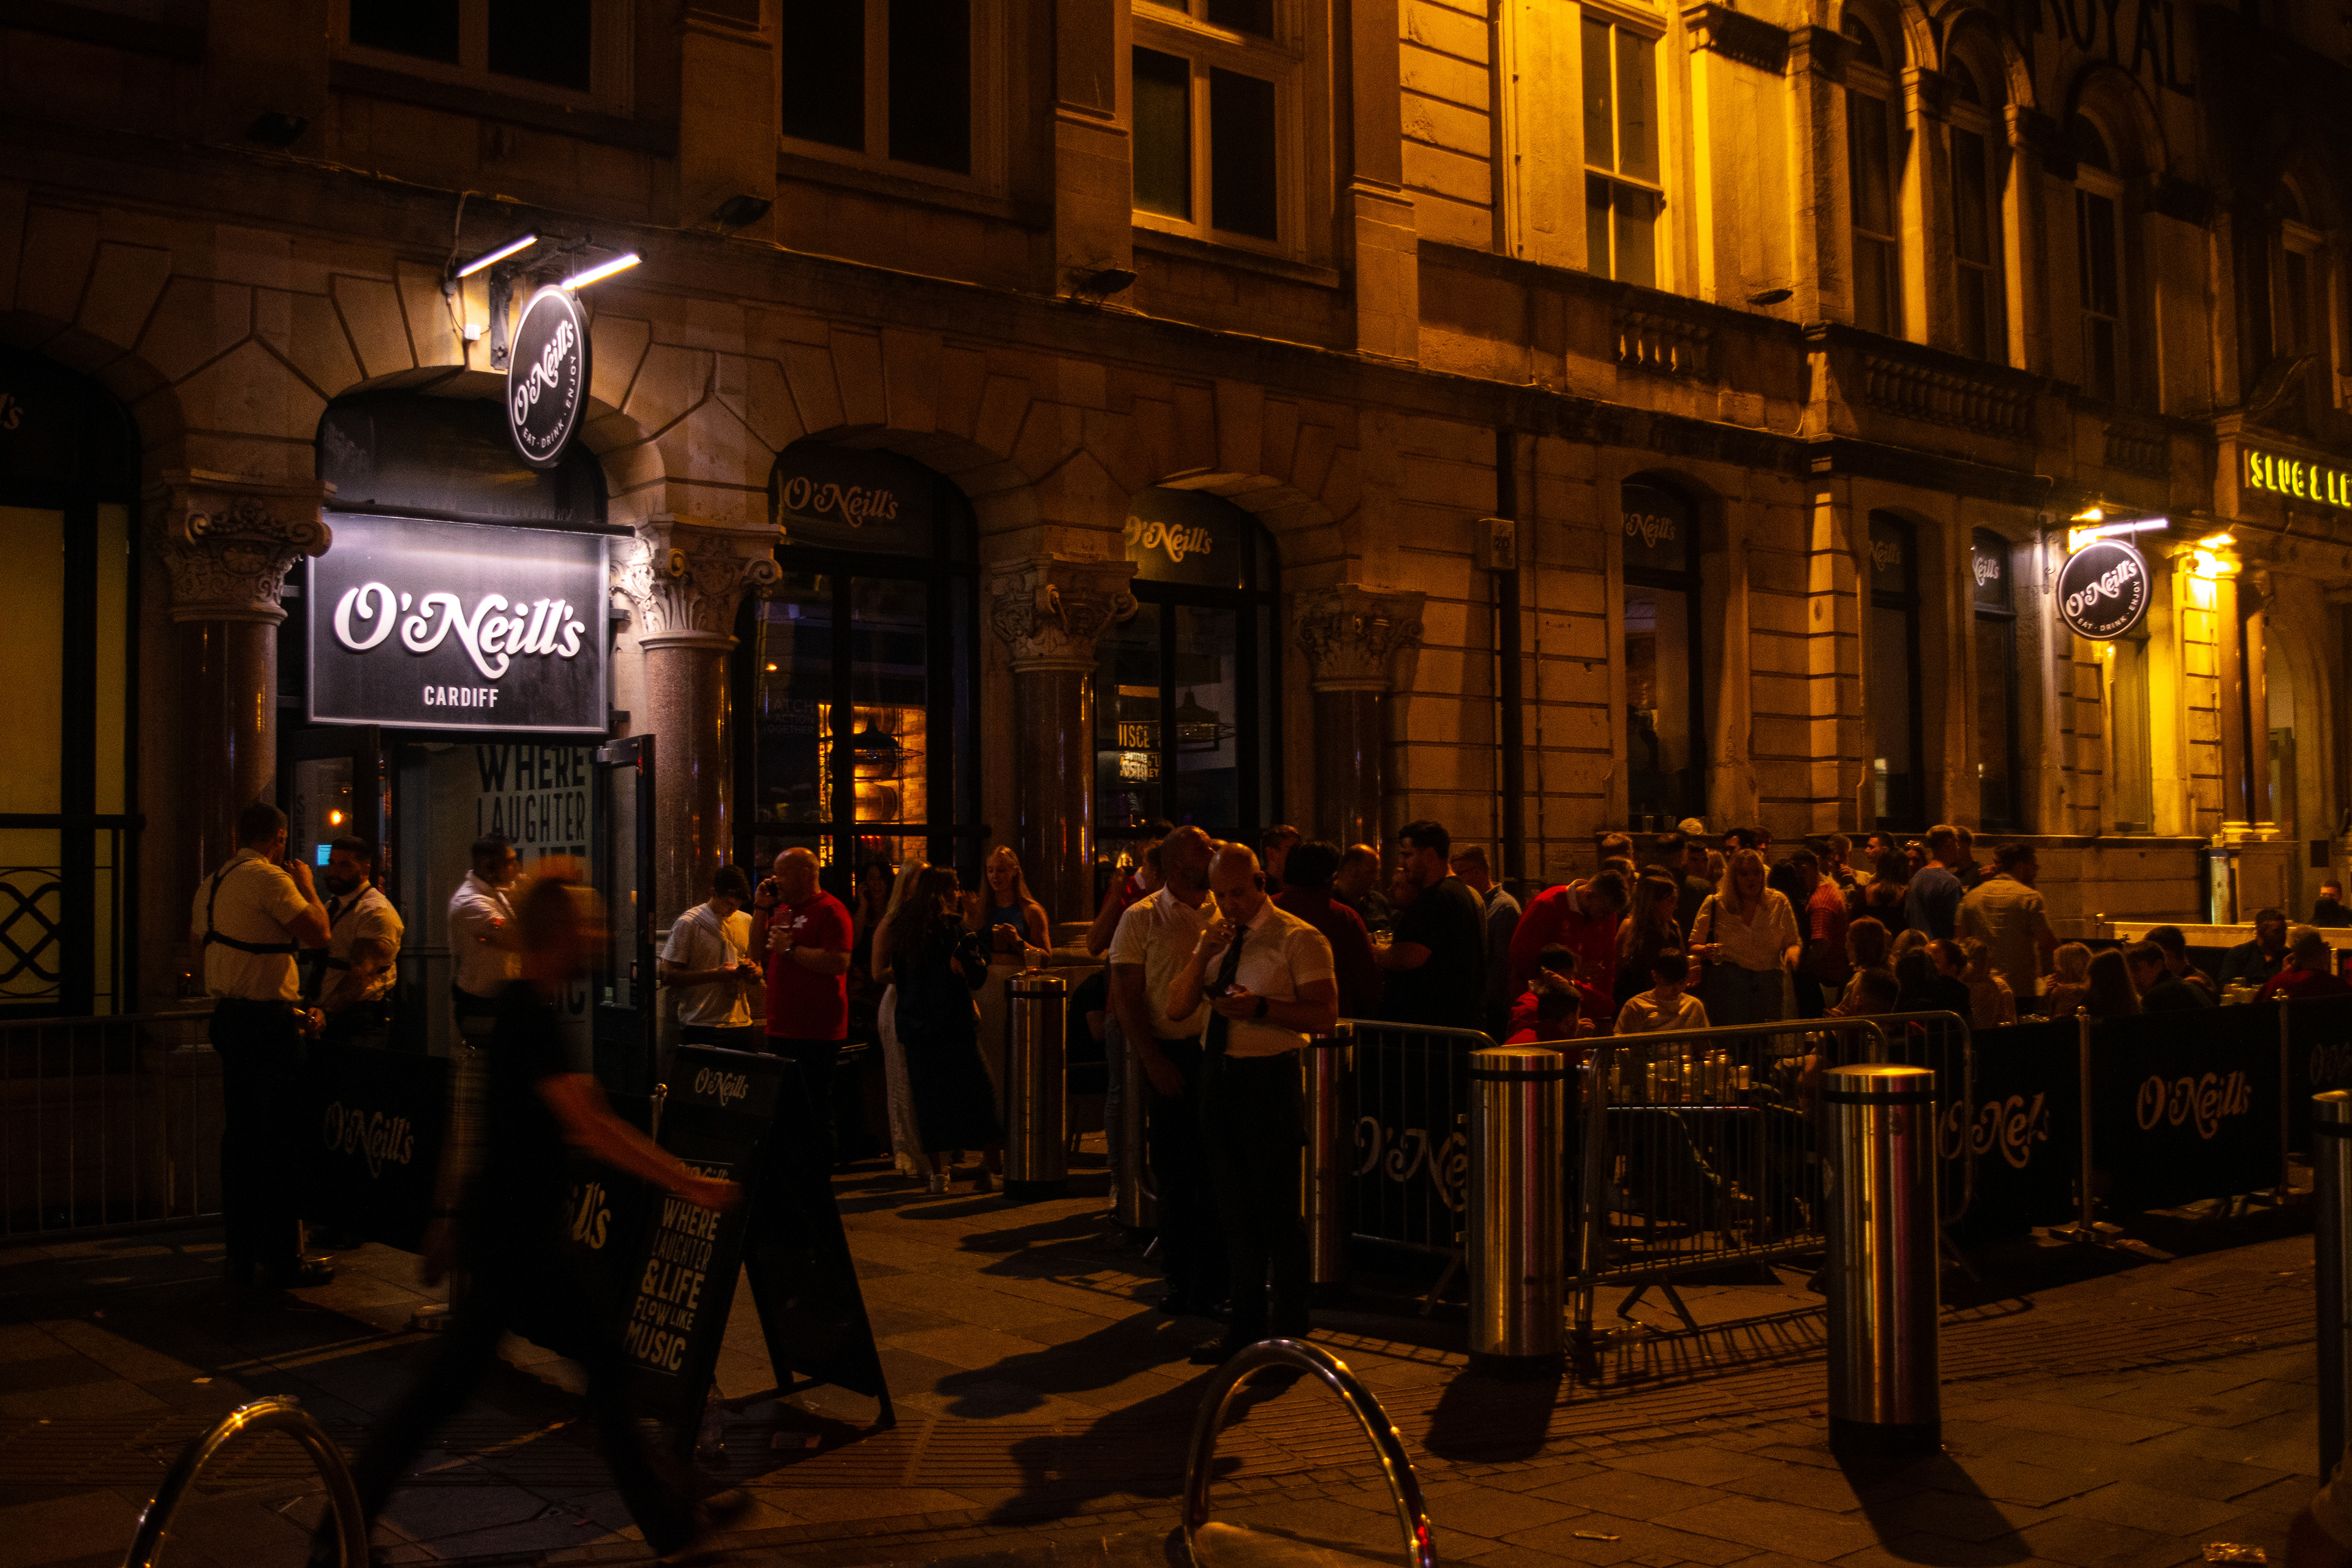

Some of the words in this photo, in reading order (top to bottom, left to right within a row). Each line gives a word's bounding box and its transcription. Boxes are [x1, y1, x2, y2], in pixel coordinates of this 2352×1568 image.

[514, 320, 574, 426] O'Neill's
[522, 428, 537, 447] EAT
[540, 420, 564, 449] DRINK
[565, 355, 577, 409] ENJOY
[784, 476, 899, 529] O'Neill's
[2065, 559, 2137, 617] O'Neill's
[2077, 617, 2093, 630] EAT
[2100, 616, 2127, 631] DRINK
[2128, 580, 2141, 612] ENJOY
[334, 582, 586, 679] O'Neill's
[424, 685, 499, 708] CARDIFF
[477, 745, 586, 793] WHERE
[477, 791, 586, 843] LAUGHTER
[693, 1067, 749, 1107] O'Neill's
[2136, 1070, 2253, 1139] O'Neill's
[323, 1101, 415, 1179] O'Neill's
[661, 1197, 722, 1241] WHERE
[651, 1227, 714, 1272] LAUGHTER
[621, 1319, 687, 1371] MUSIC
[669, 1306, 696, 1332] LIKE
